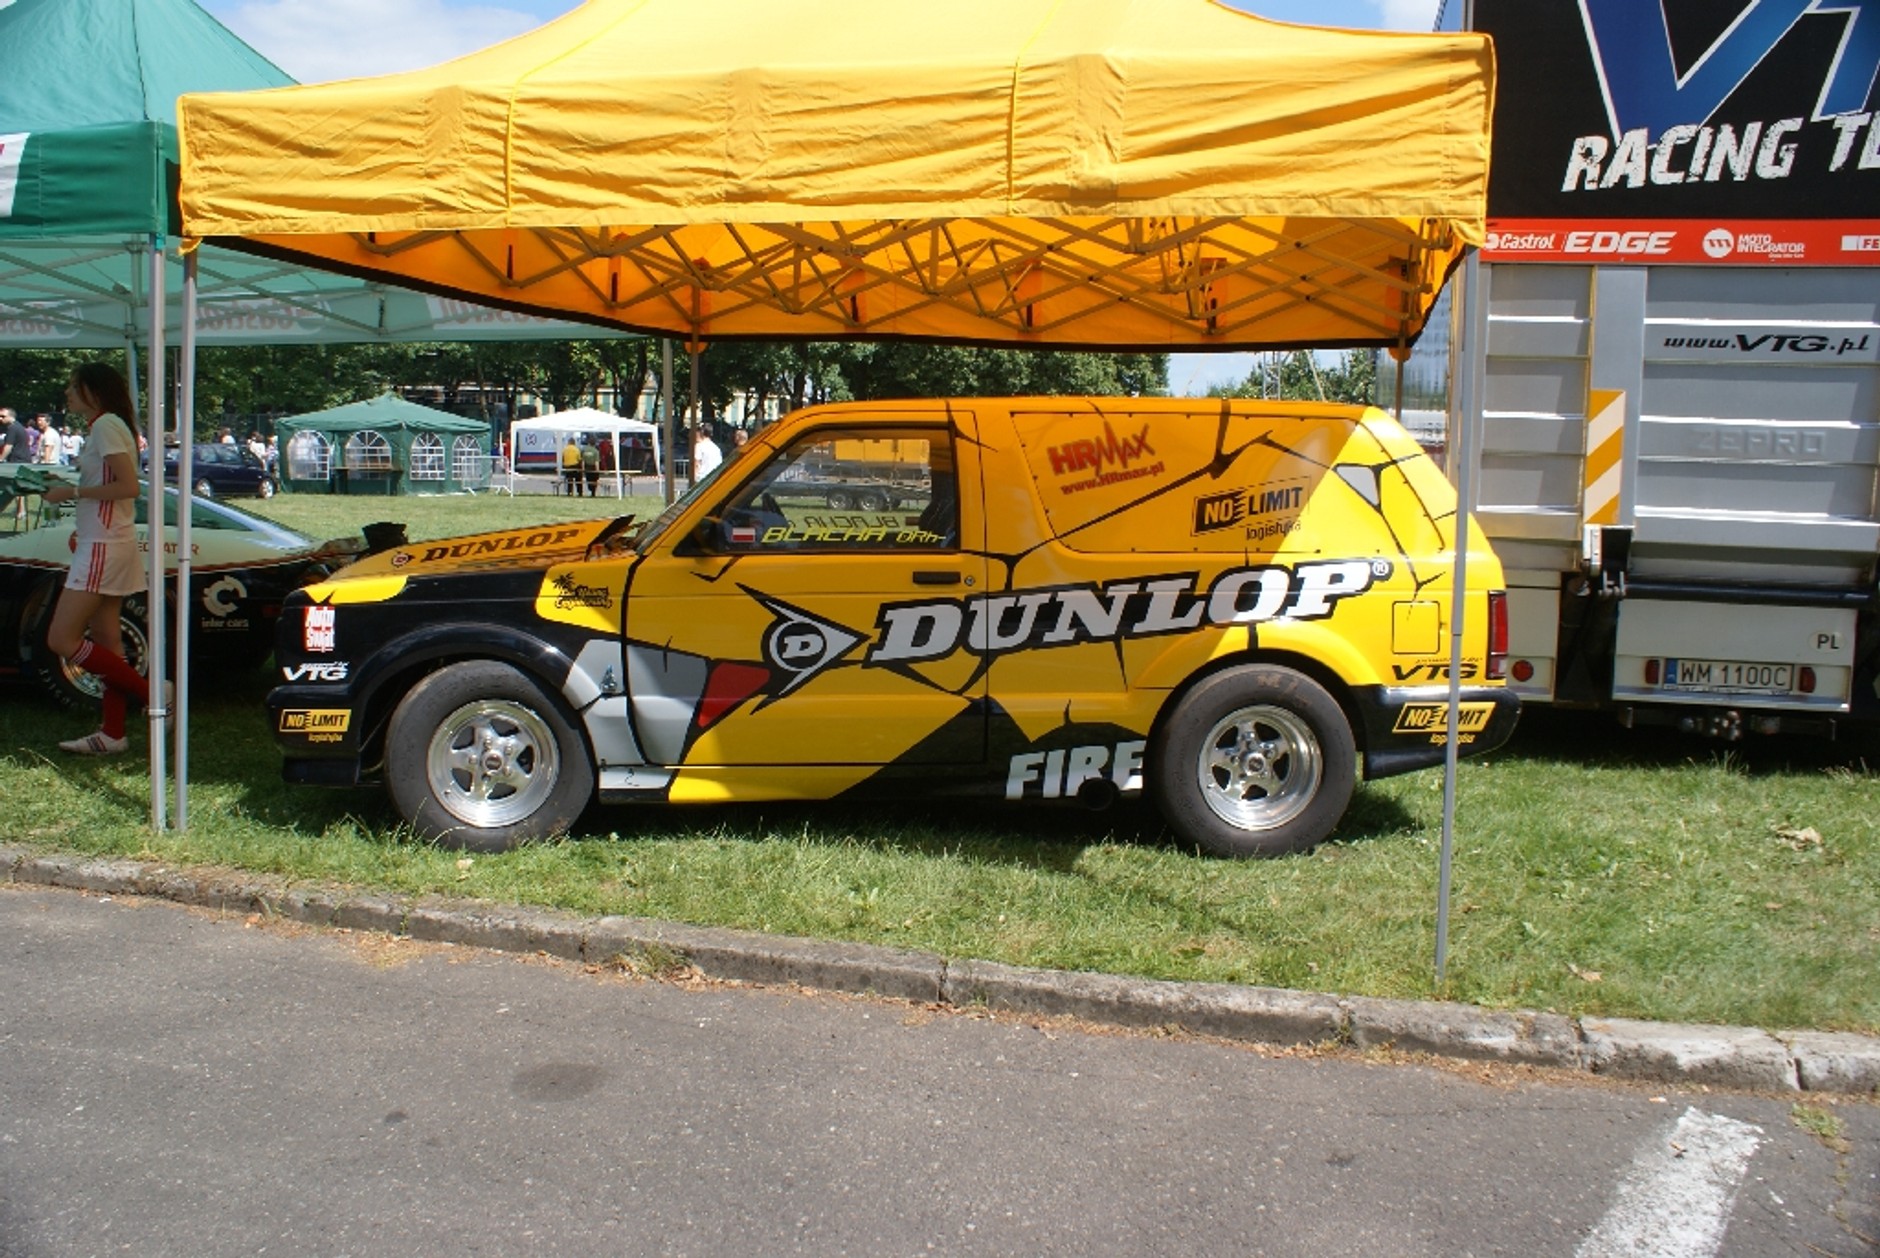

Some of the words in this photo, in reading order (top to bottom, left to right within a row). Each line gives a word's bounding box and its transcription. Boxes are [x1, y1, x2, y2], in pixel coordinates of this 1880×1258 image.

[1561, 118, 1803, 192] RACING
[1499, 233, 1556, 249] Castrol
[1565, 231, 1677, 254] EDGE
[1737, 243, 1805, 254] INTEGRATOR
[1738, 234, 1772, 244] MOTO
[1664, 334, 1870, 356] www.VTG.pl
[1695, 428, 1826, 454] ZEPRO
[1204, 501, 1234, 525] NO
[1249, 487, 1303, 516] LIMIT
[420, 528, 580, 562] DUNLOP
[761, 527, 887, 543] BLACHA
[1817, 634, 1839, 649] PL
[282, 664, 349, 681] VTG
[1681, 663, 1711, 683] WM
[1722, 665, 1787, 686] 1100C
[286, 714, 305, 727] NO
[312, 714, 346, 726] LIMIT
[1404, 709, 1432, 726] NO
[1006, 740, 1146, 799] FIRE
